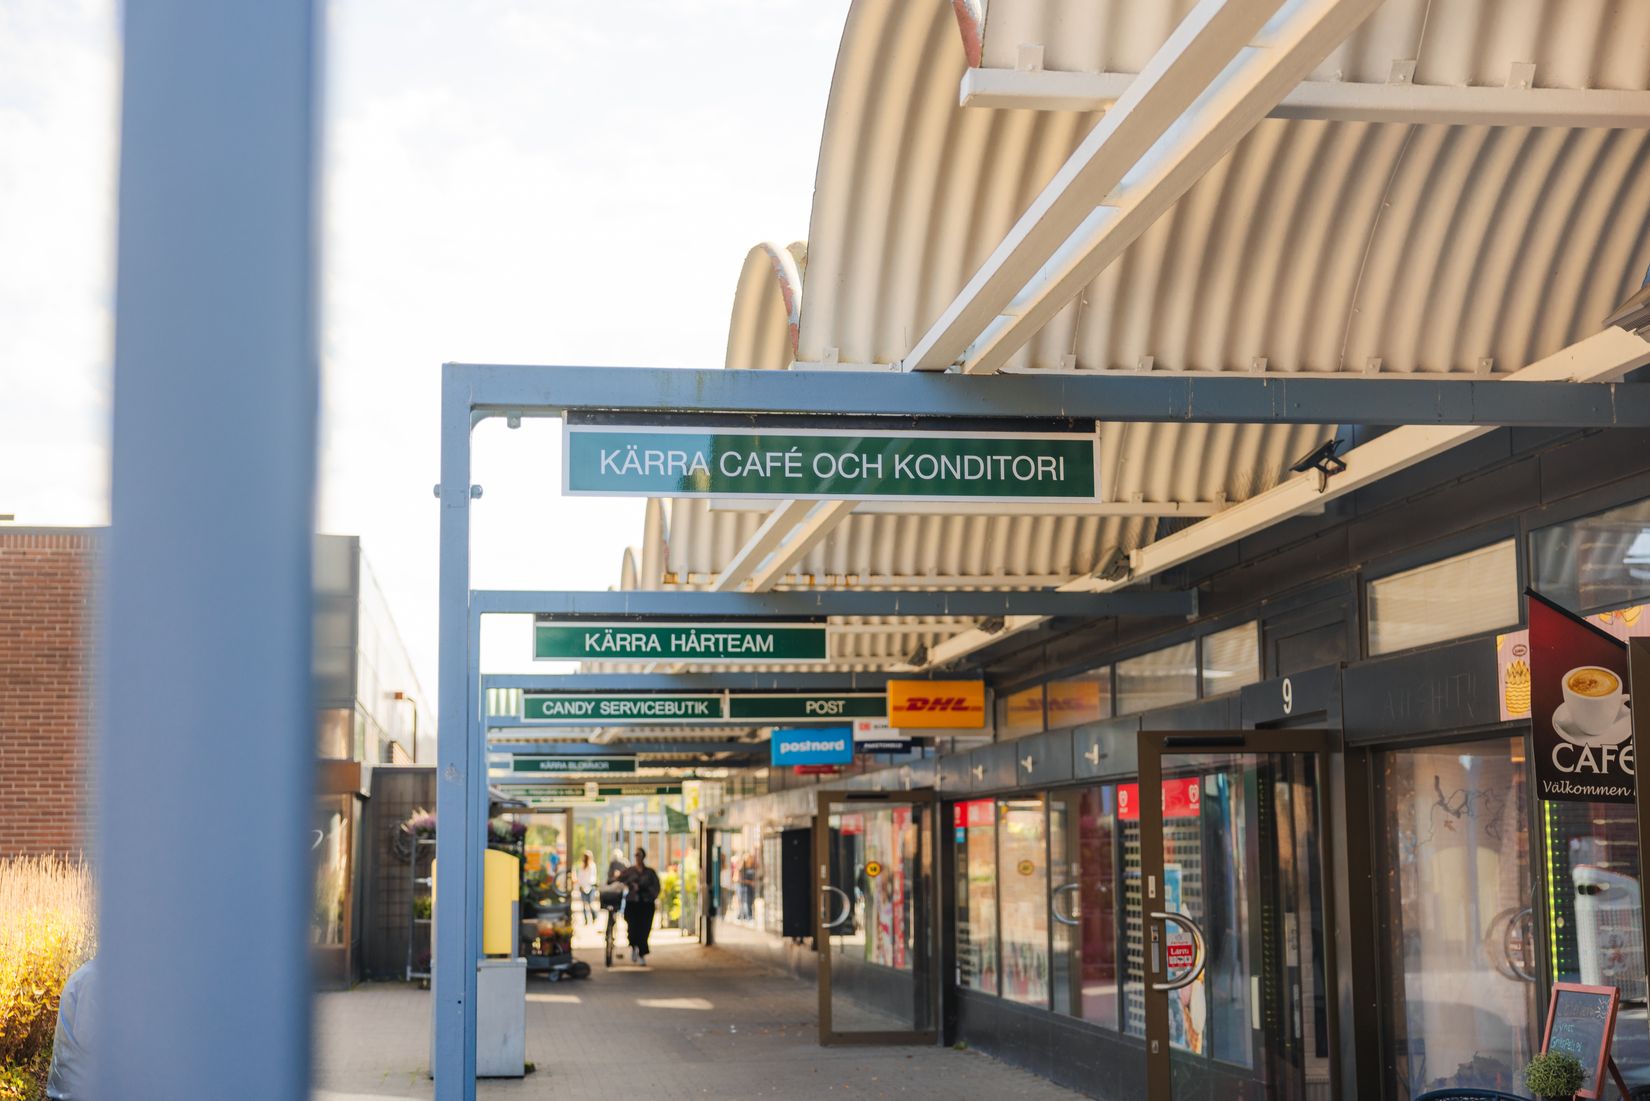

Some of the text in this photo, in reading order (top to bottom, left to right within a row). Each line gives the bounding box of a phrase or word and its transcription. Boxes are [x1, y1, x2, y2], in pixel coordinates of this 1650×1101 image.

[600, 446, 1065, 481] KÄRRA CAFÉ OCH KONDITORI
[585, 629, 774, 653] KÄRRA HÅRTEAM
[1282, 678, 1293, 714] 9
[542, 701, 709, 716] CANDY SERVICEBUTIK
[805, 701, 846, 714] POST
[906, 697, 970, 712] DHL
[779, 739, 845, 754] postnord
[1543, 780, 1631, 797] Välkommen
